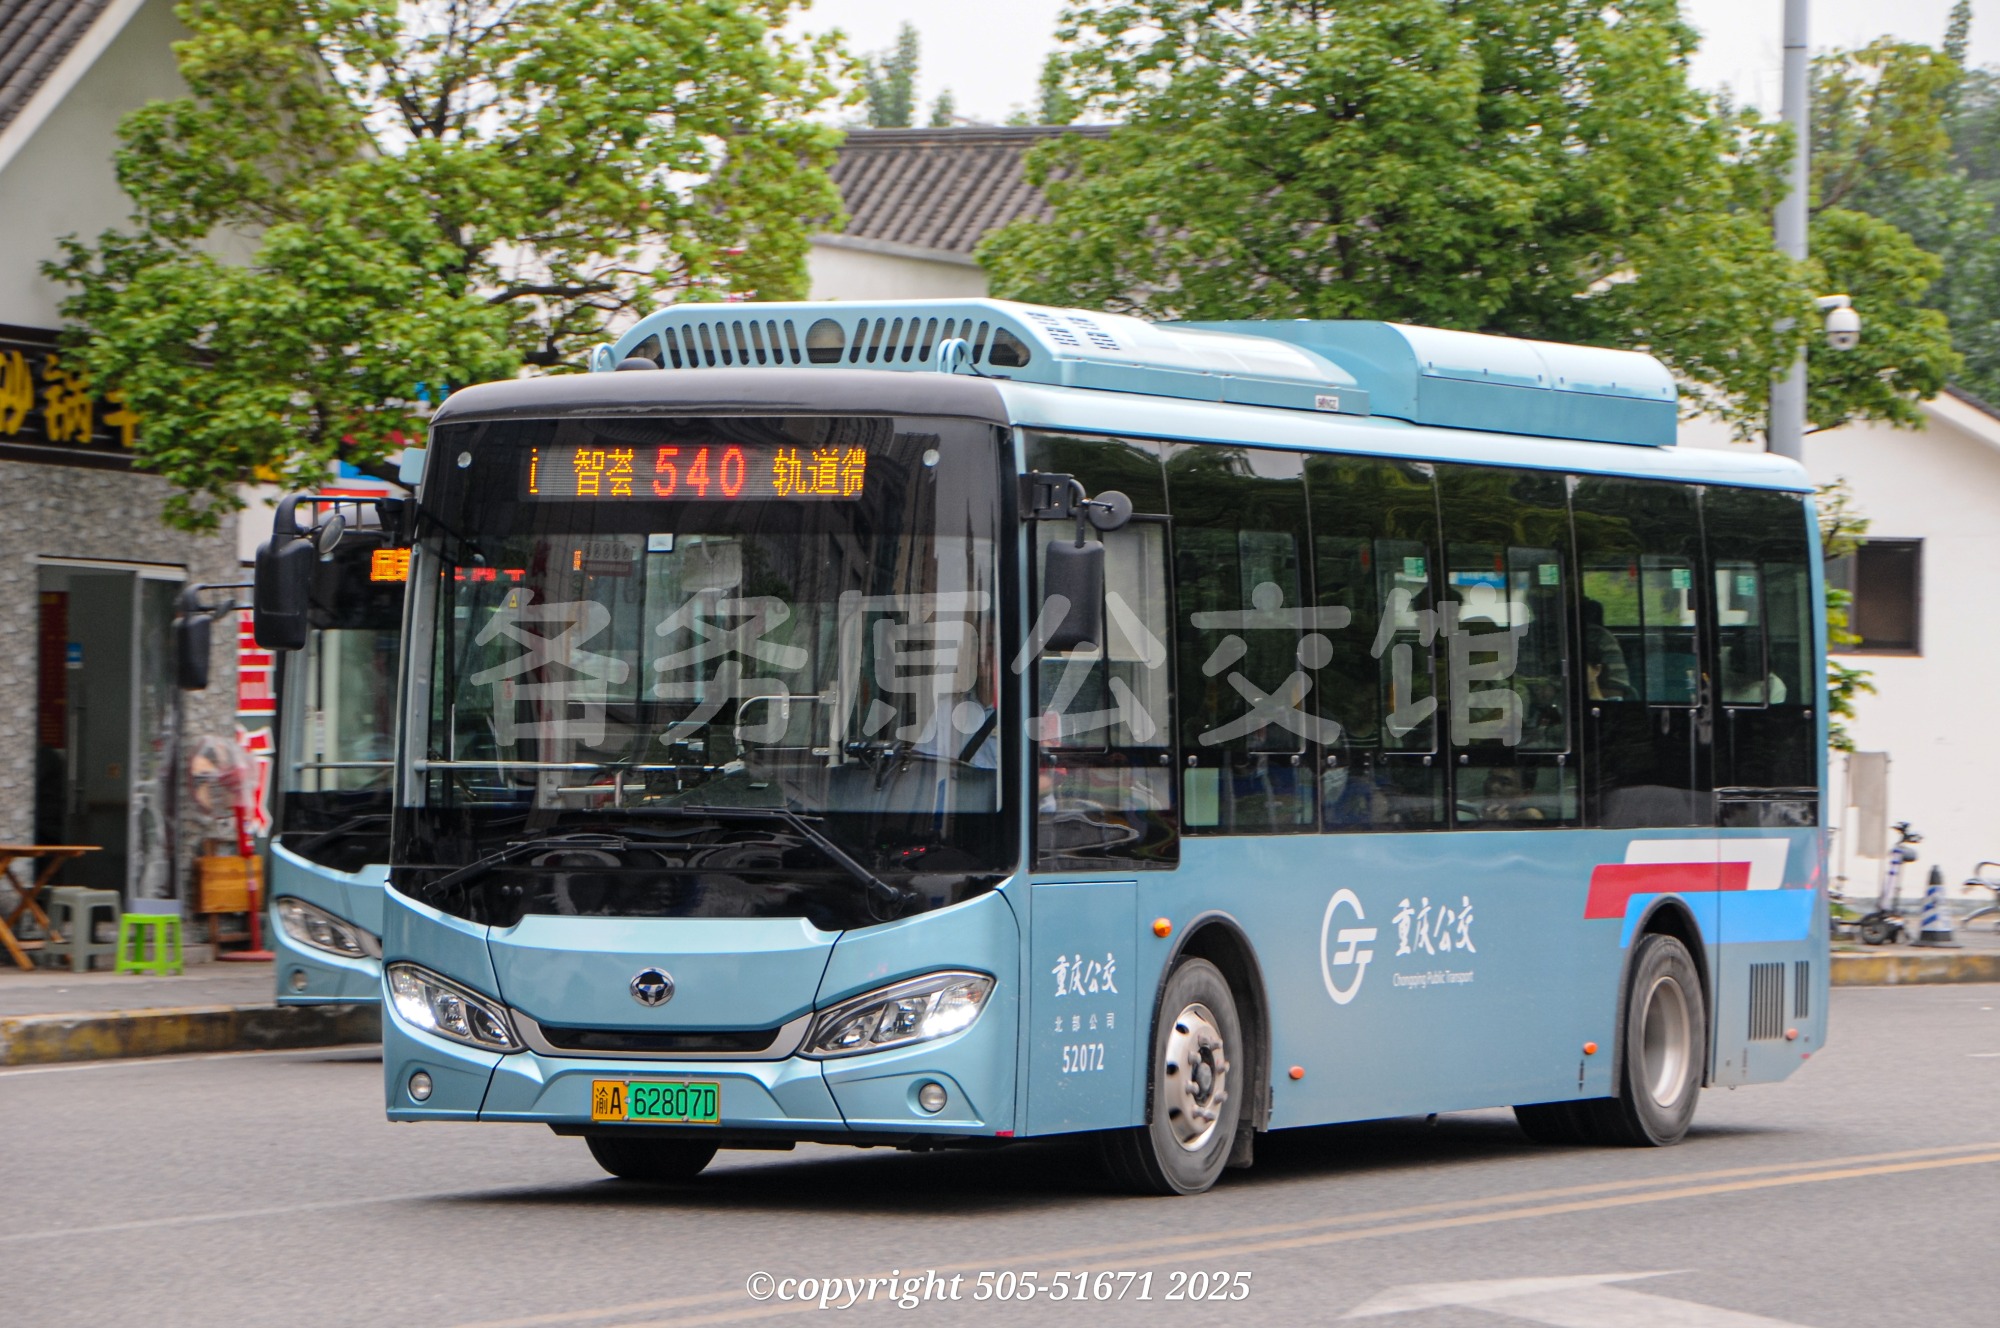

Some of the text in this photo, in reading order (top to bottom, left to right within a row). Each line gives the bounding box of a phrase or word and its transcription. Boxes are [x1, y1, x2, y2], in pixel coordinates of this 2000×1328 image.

[652, 446, 745, 497] 540
[1392, 895, 1477, 957] 重庆公交
[1051, 952, 1119, 997] 重庆公交
[1062, 1042, 1105, 1074] 52072
